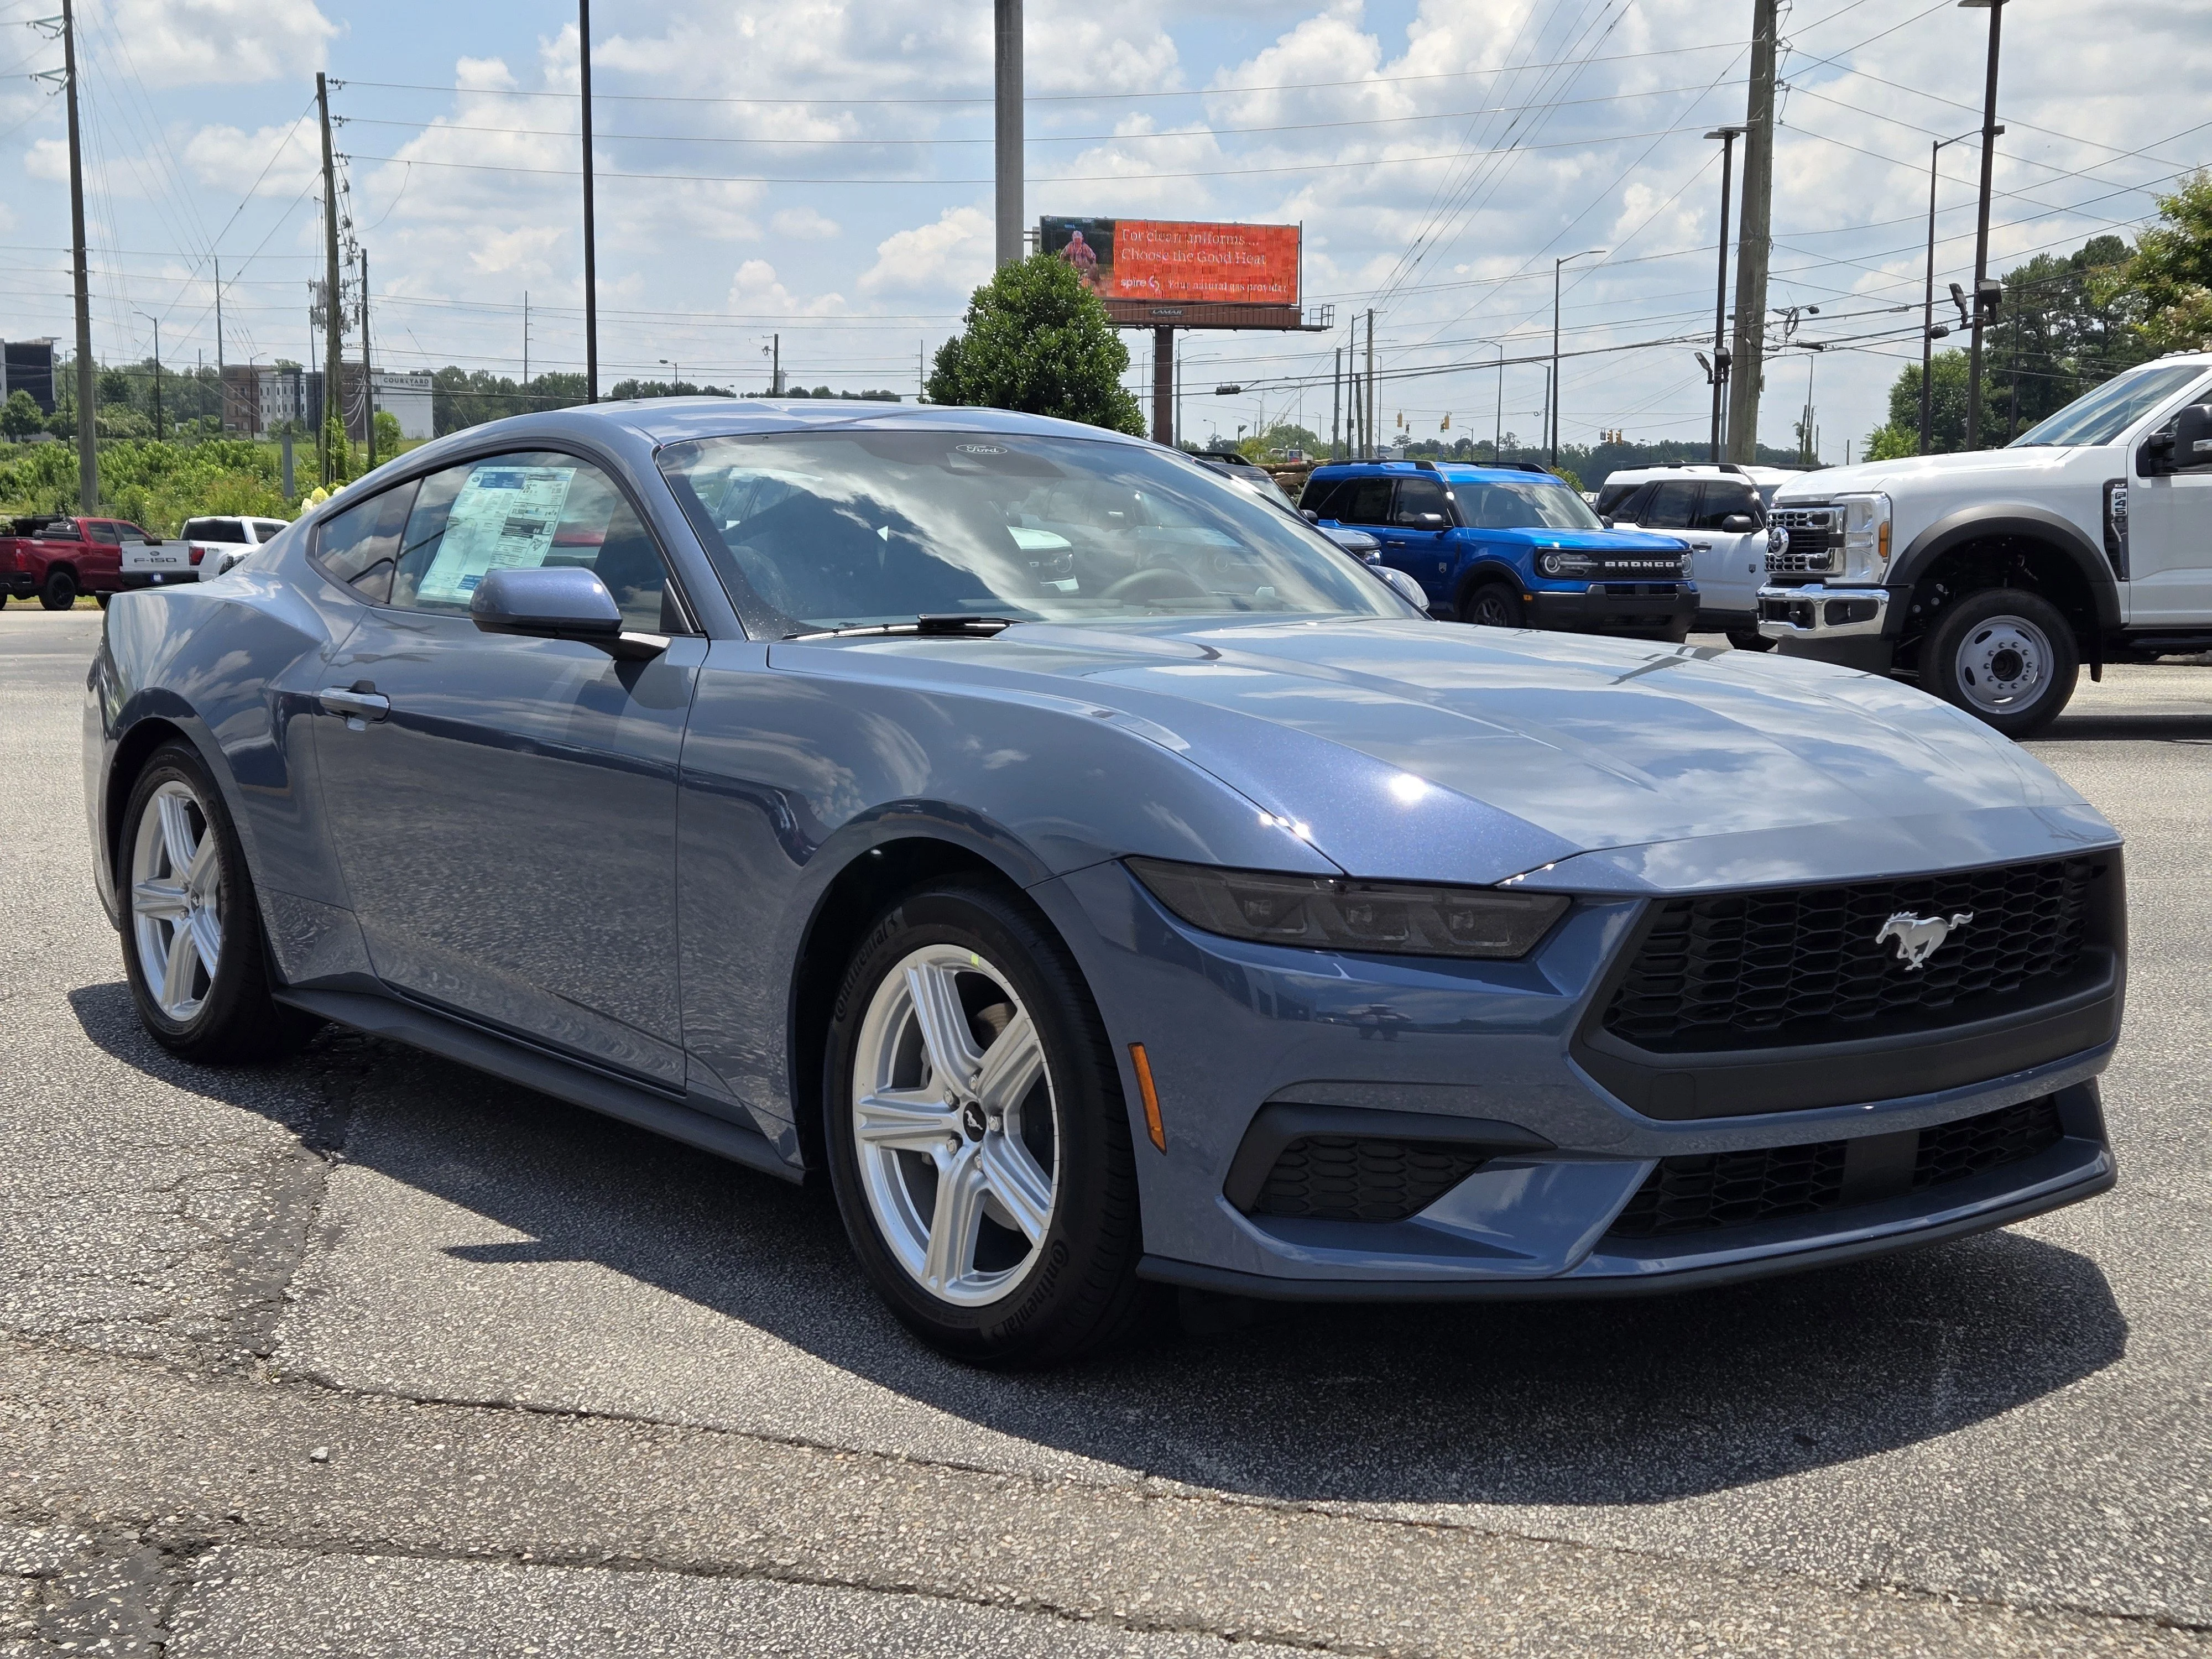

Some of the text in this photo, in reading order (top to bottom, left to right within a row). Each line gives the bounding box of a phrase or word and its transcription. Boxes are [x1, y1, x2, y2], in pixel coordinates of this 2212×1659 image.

[1173, 249, 1193, 263] the
[2115, 492, 2126, 523] F450
[1002, 1239, 1070, 1338] Continental
